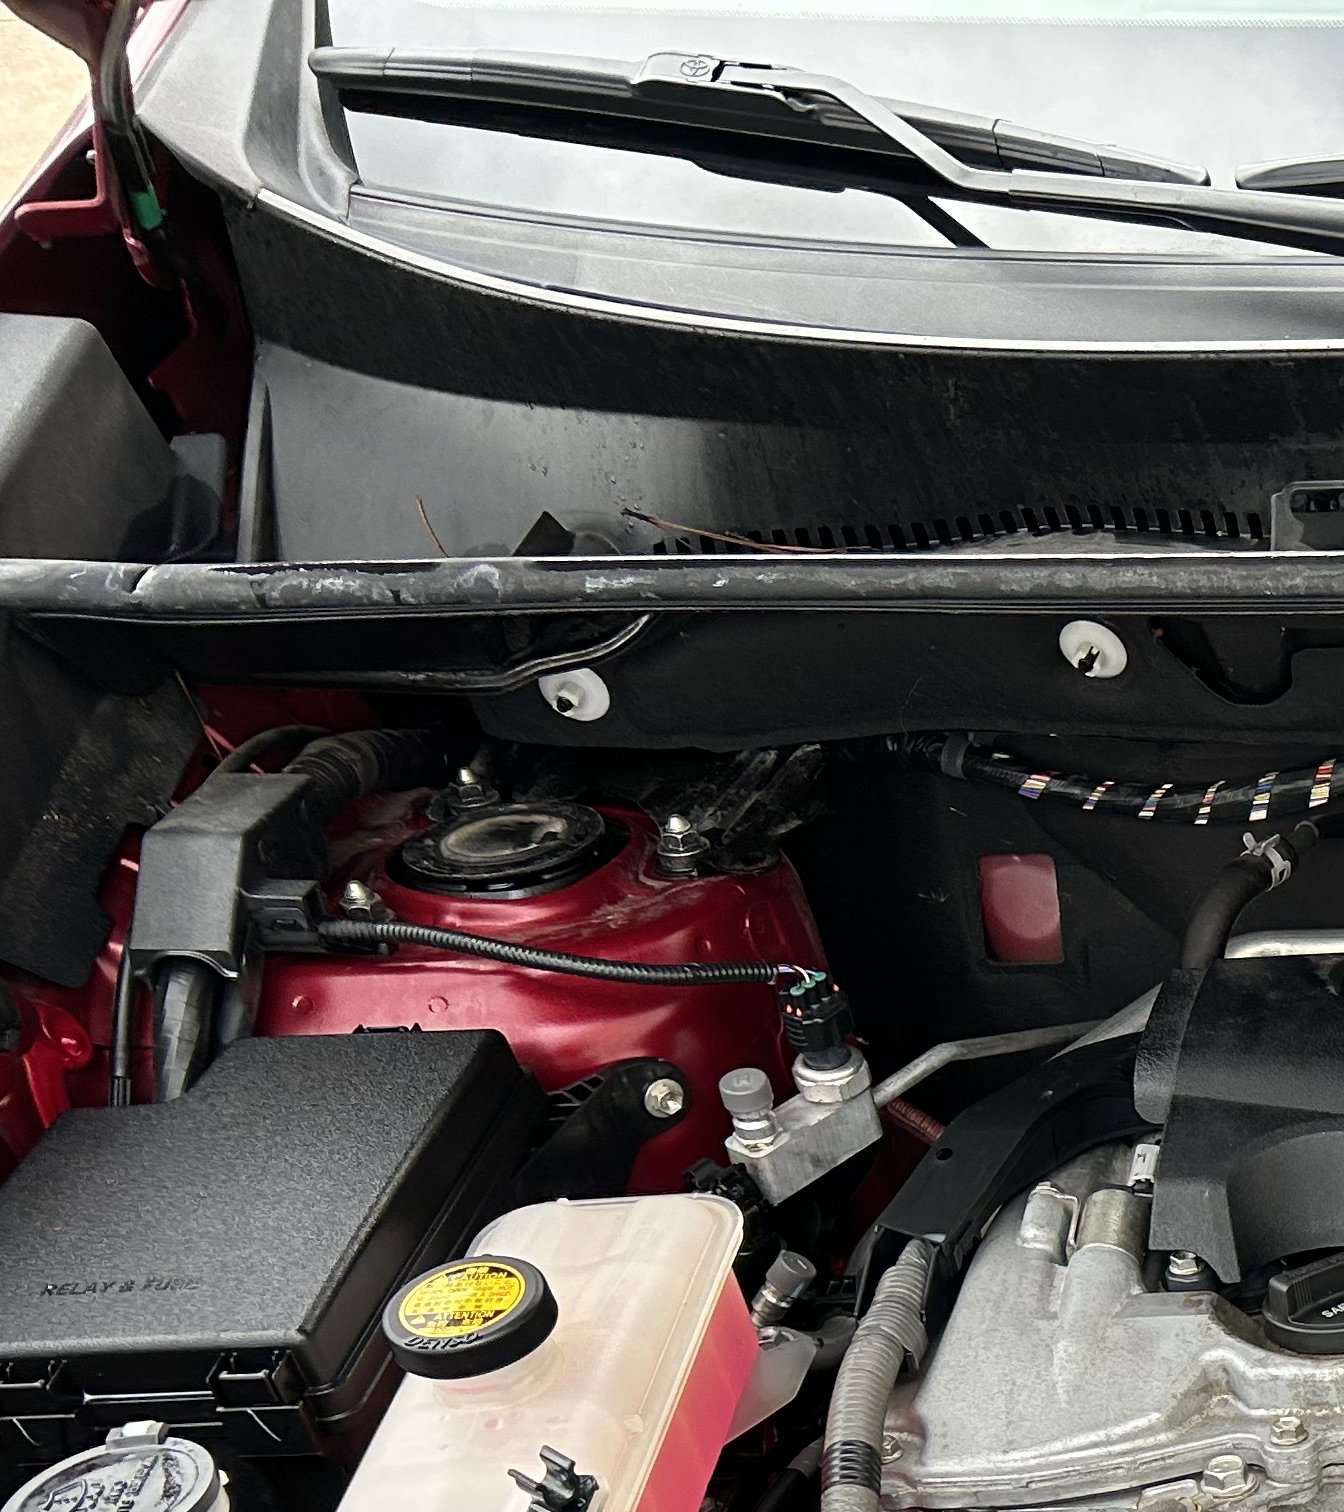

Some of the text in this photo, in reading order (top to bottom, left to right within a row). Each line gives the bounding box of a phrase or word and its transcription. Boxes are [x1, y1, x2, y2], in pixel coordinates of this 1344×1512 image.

[40, 1280, 116, 1297] RELAY
[119, 1279, 137, 1294] &
[433, 1310, 495, 1321] ATTENTION
